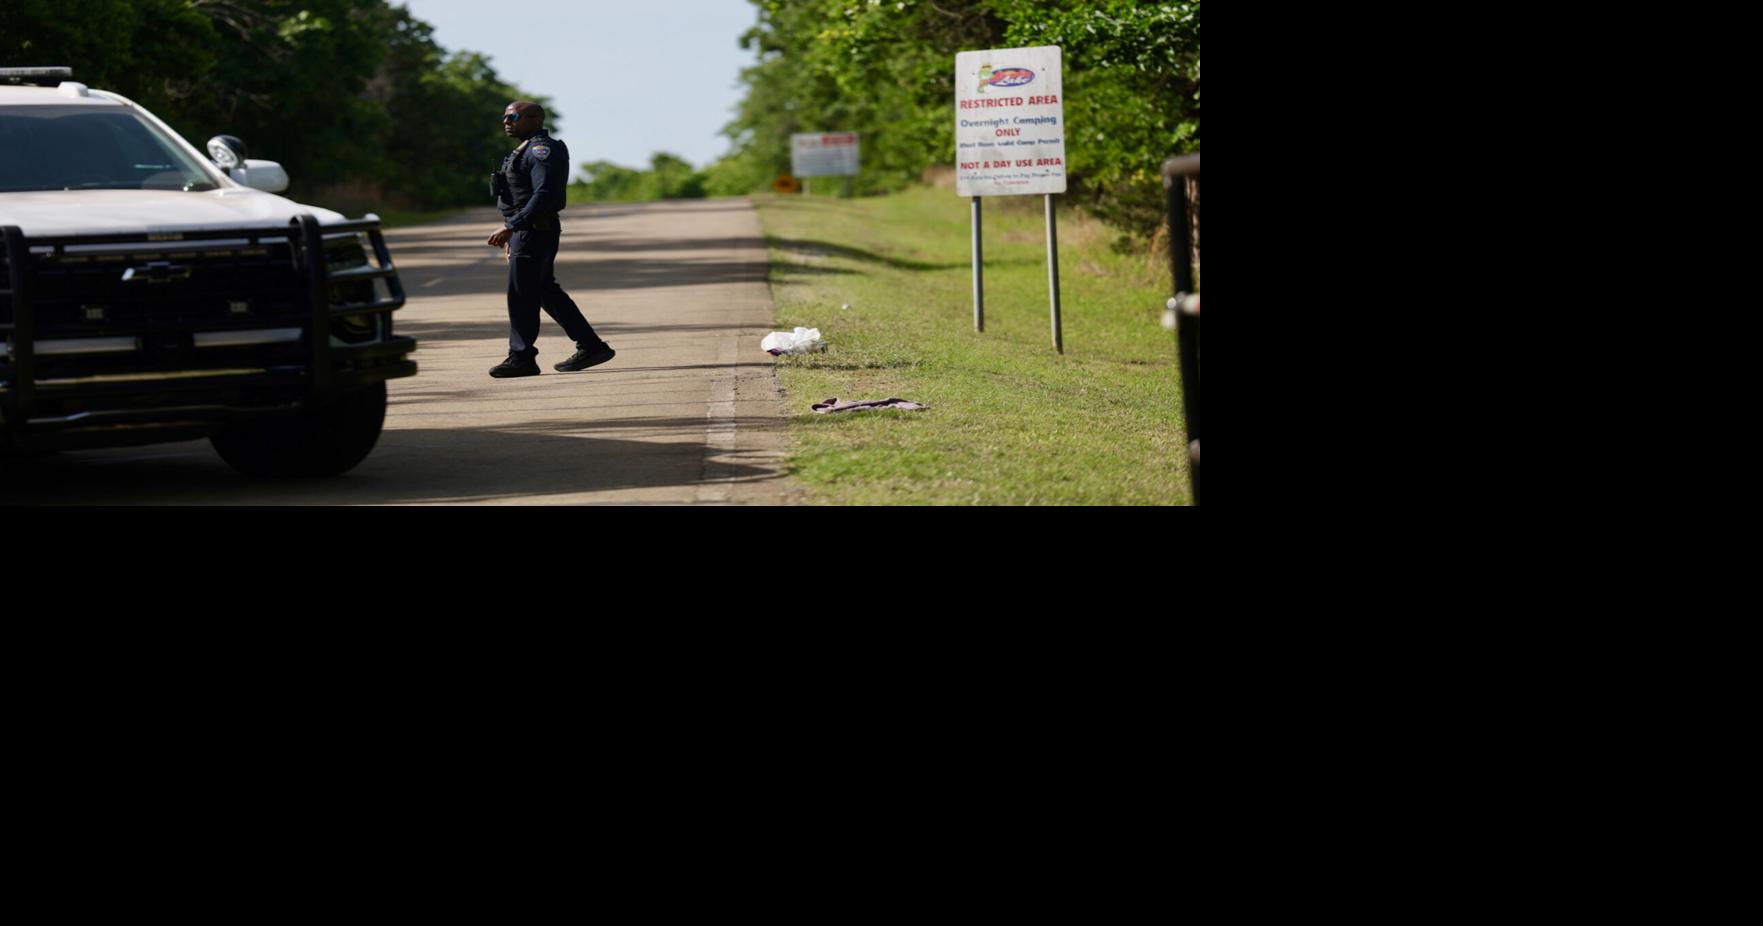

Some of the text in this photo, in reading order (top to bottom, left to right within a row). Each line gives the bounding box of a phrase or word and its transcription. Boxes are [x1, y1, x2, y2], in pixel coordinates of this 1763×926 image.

[960, 95, 1058, 109] RESTRICTED AREA
[960, 116, 1057, 128] Overnight Camping
[995, 128, 1020, 137] ONLY
[960, 158, 1062, 170] NOT A DAY USE AREA
